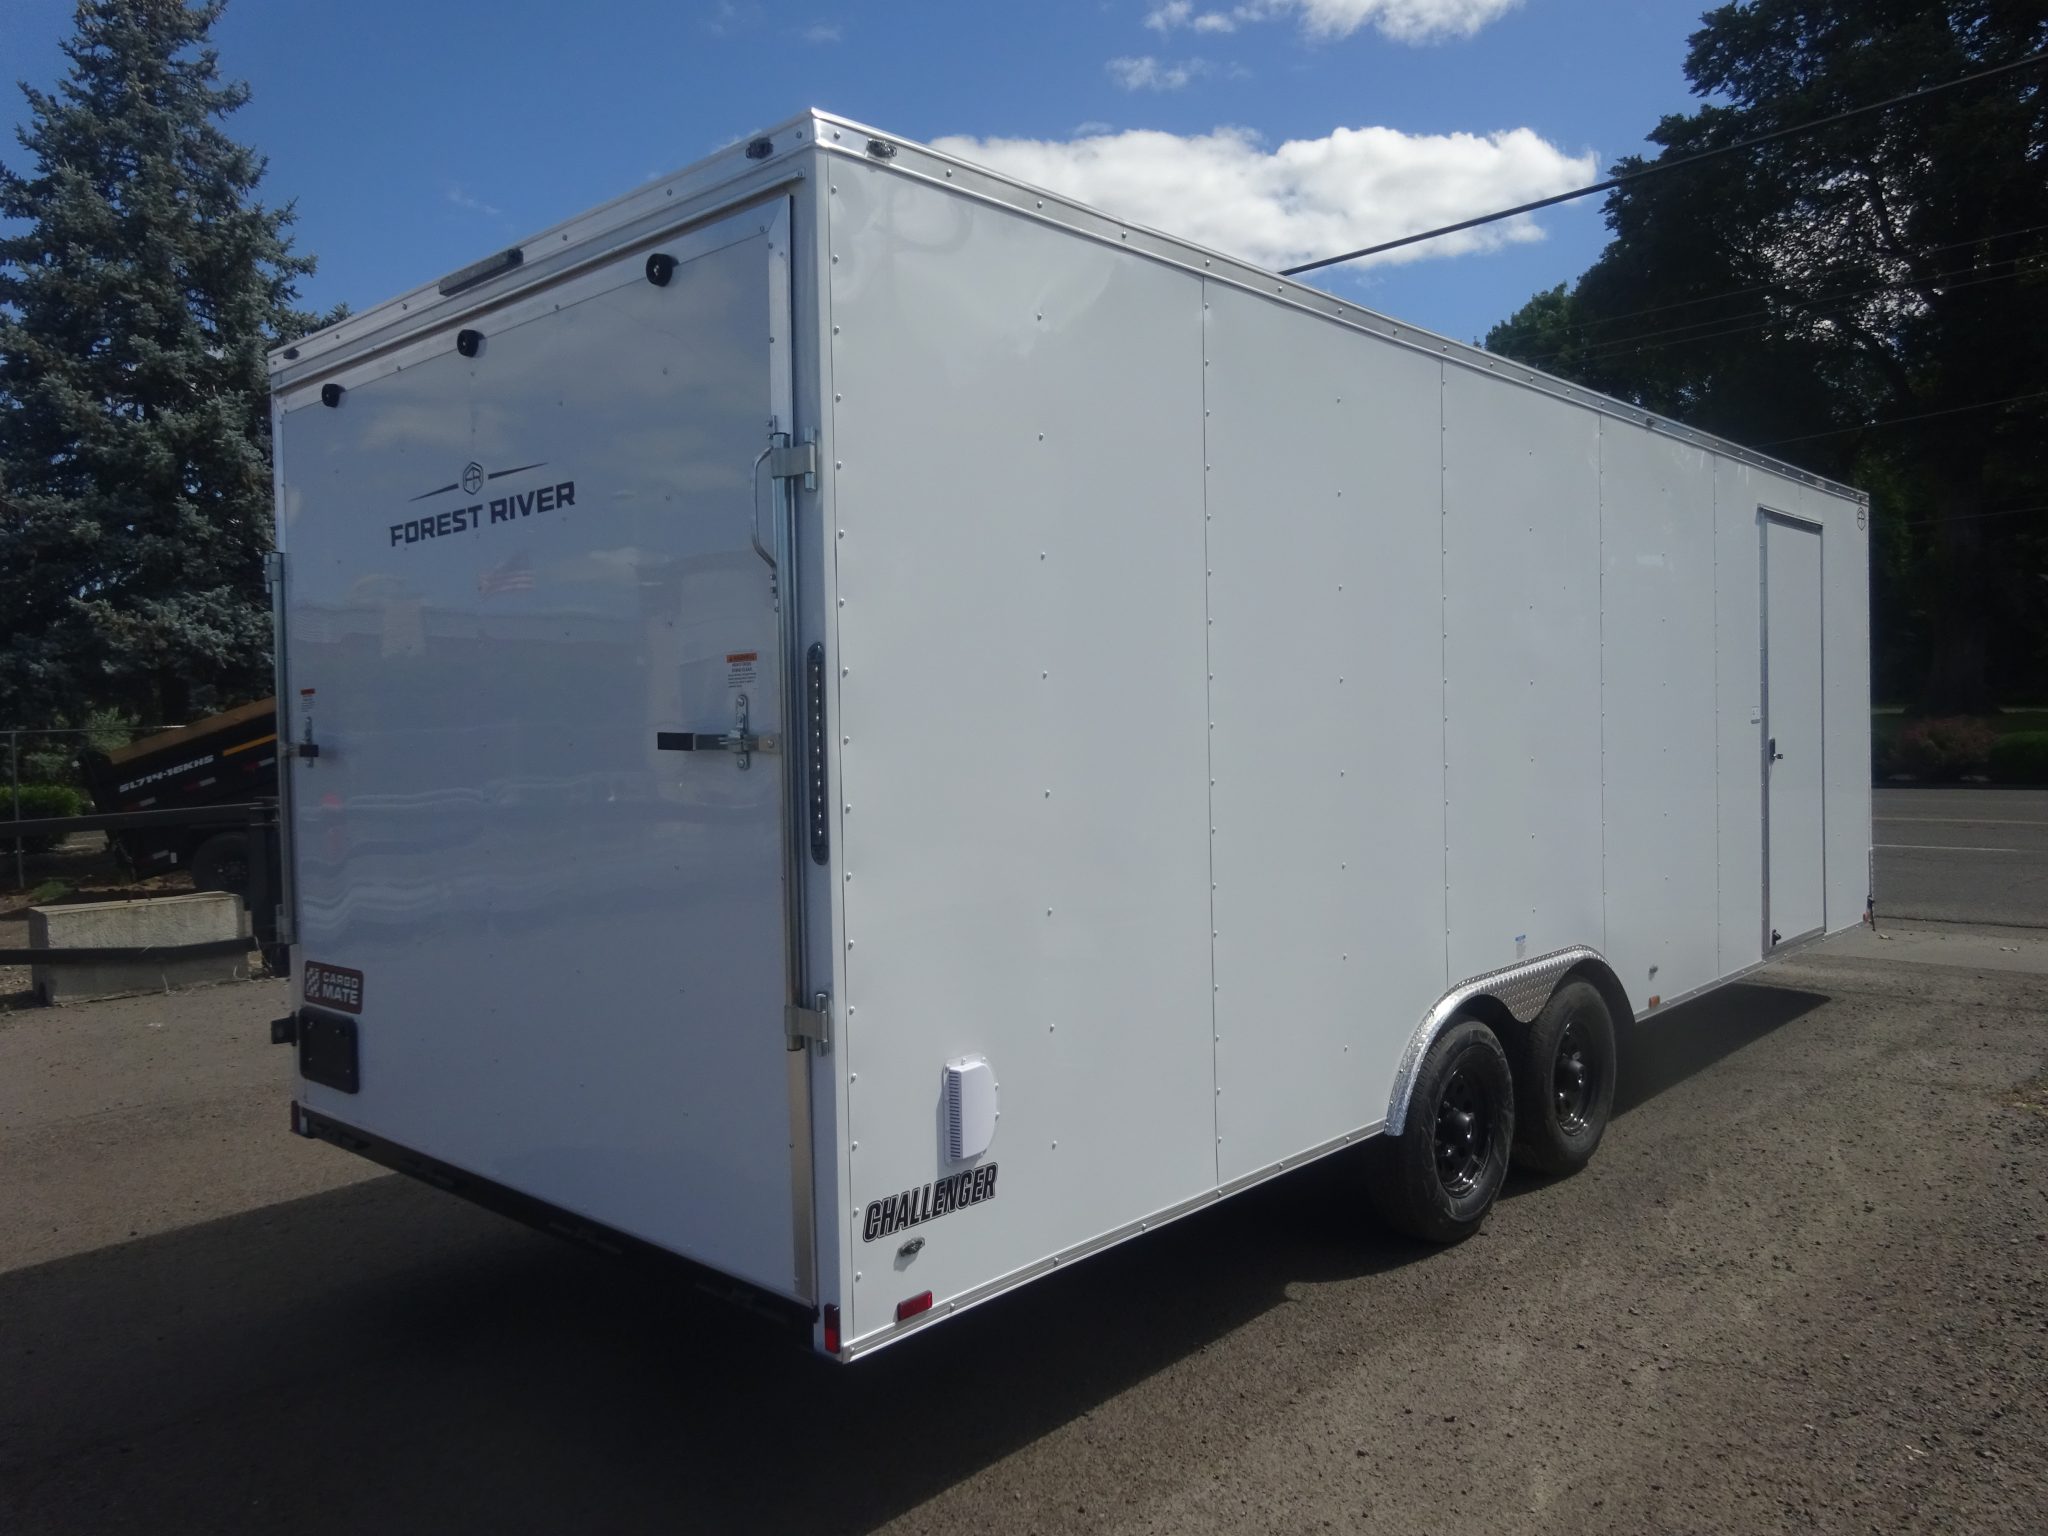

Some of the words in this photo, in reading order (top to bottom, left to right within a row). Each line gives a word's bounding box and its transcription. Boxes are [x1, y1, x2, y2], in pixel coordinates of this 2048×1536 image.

[389, 504, 483, 547] FOREST
[490, 481, 575, 524] RIVER
[322, 972, 359, 989] CARGO
[322, 983, 359, 1005] MATE
[863, 1162, 998, 1242] CHALLENGER
